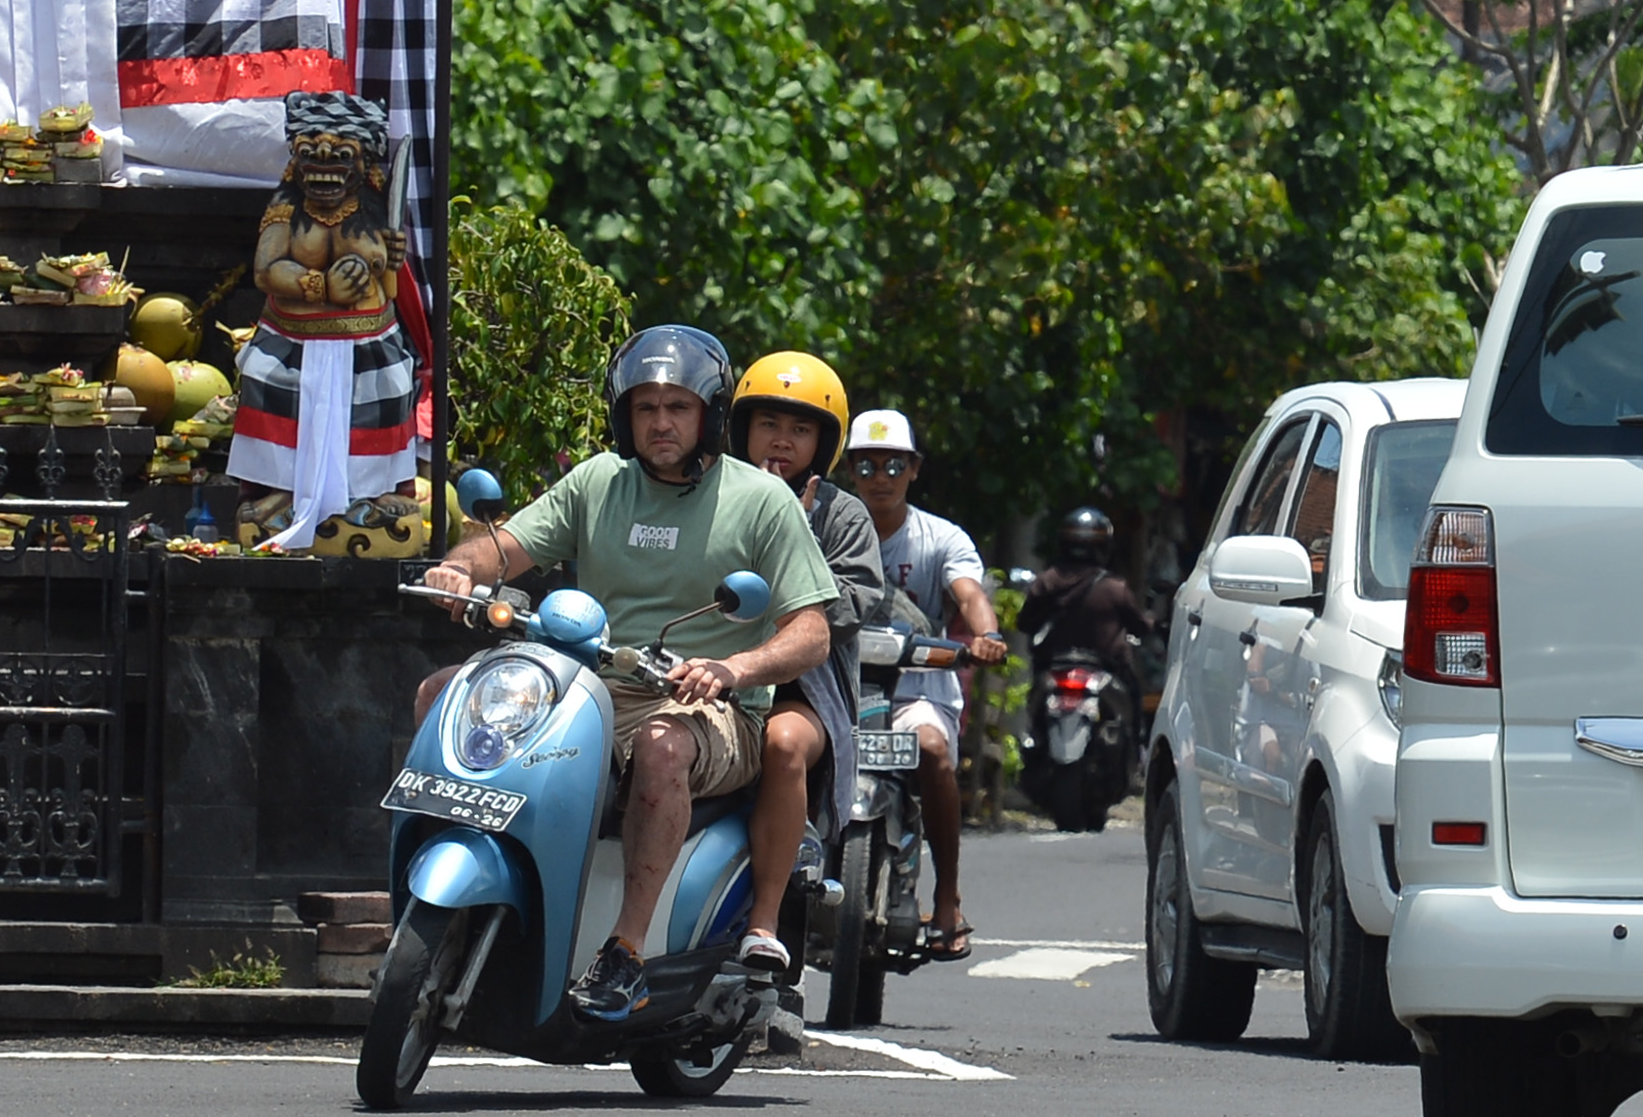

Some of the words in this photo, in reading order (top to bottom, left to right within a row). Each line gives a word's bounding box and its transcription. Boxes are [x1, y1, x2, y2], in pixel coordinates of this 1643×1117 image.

[640, 525, 670, 538] GOOD
[637, 536, 670, 550] VIBES
[398, 771, 433, 793] DK
